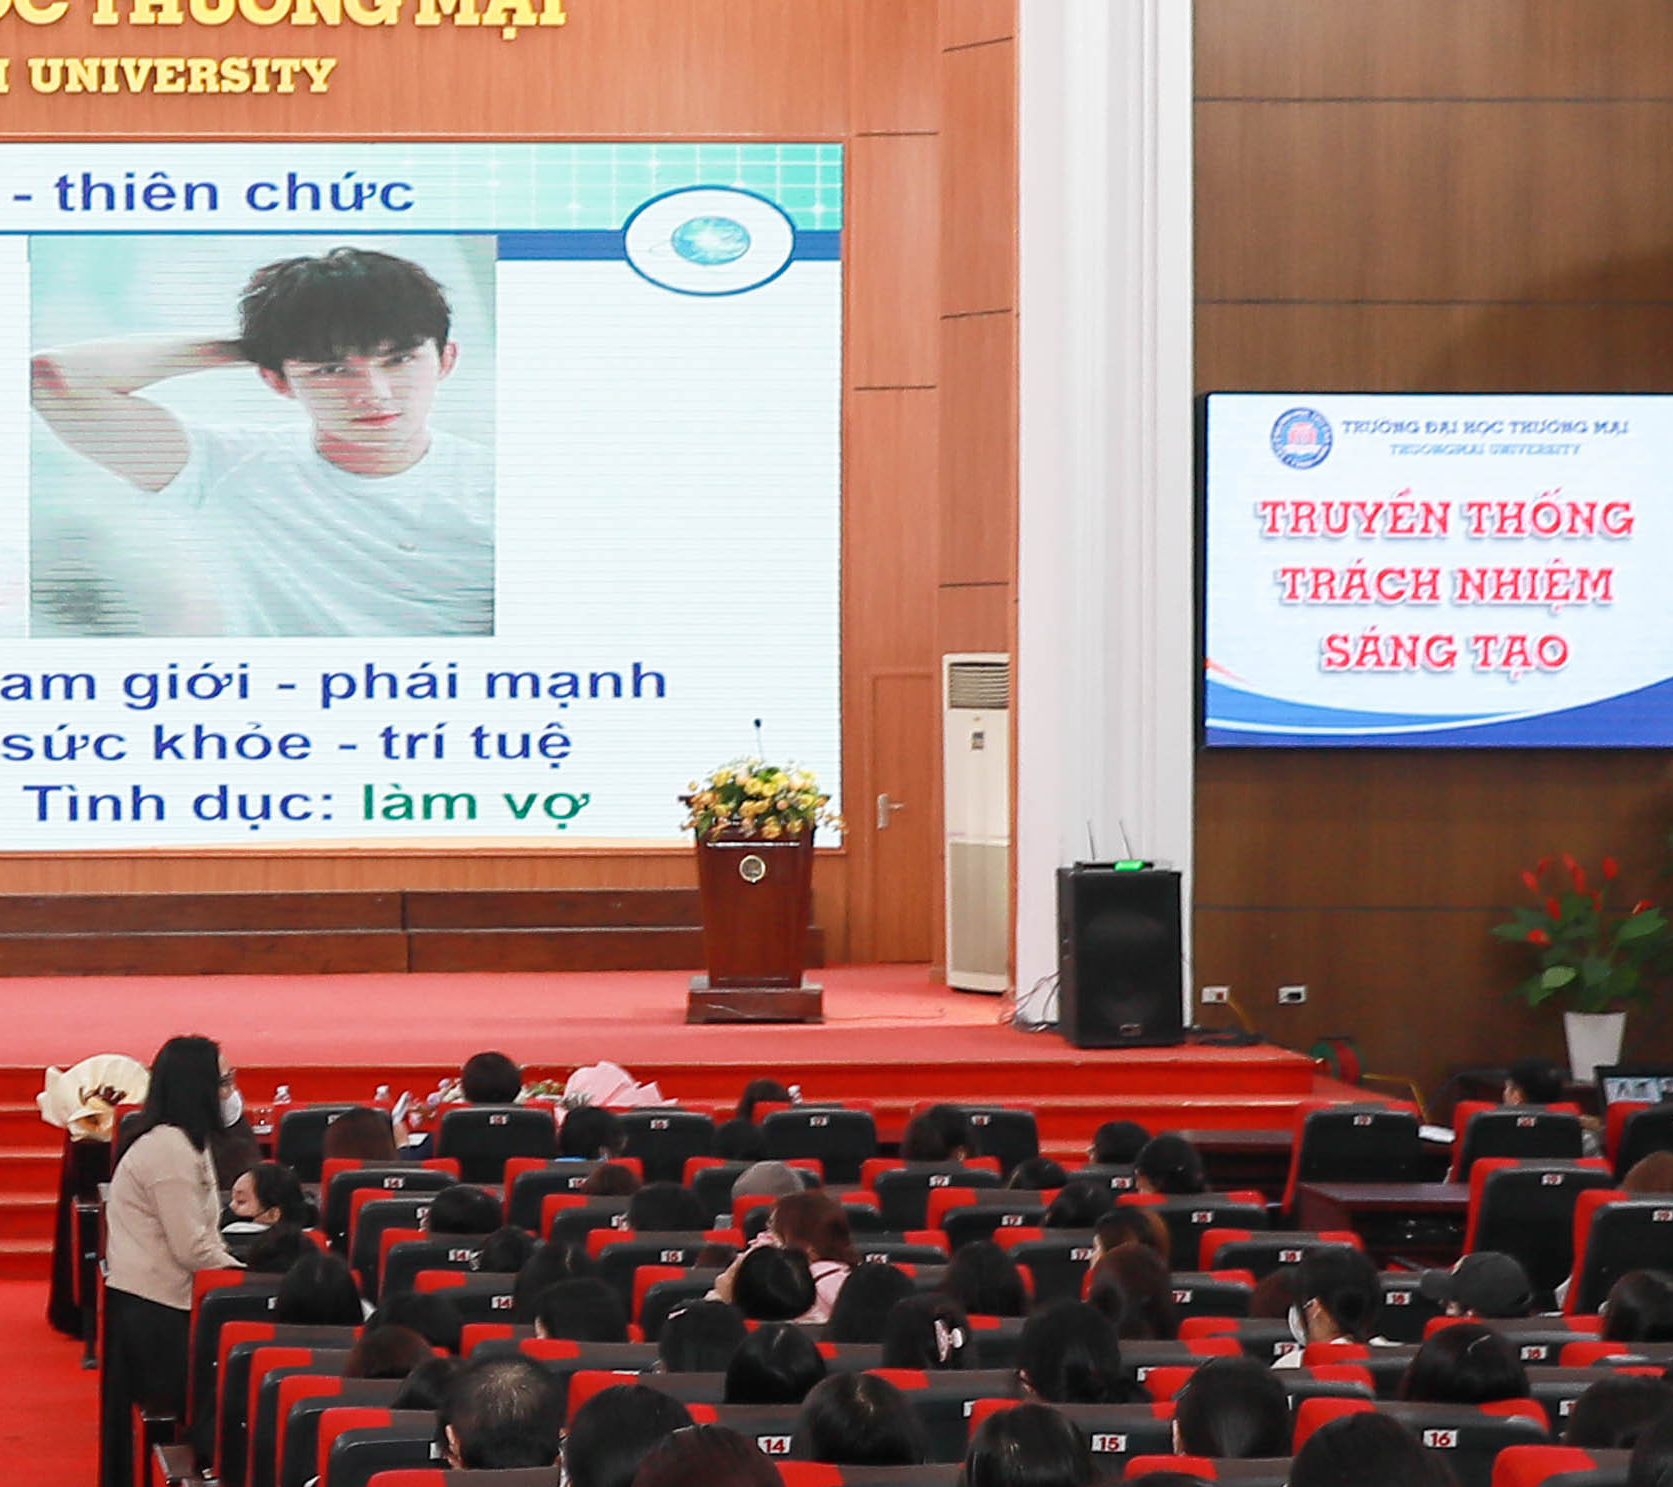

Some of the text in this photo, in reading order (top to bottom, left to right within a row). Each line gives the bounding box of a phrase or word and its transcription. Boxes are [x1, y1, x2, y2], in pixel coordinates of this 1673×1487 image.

[28, 57, 337, 94] UNIVERSITY
[54, 171, 218, 212] thiên
[245, 171, 414, 212] chức
[1281, 558, 1614, 612] TRÁCH NHIỆM
[1324, 624, 1569, 677] SÁNG TẠO
[123, 662, 250, 711] giới
[321, 661, 458, 710] phái
[486, 661, 666, 709] mạnh
[1, 723, 126, 762] sức
[154, 723, 312, 761] khỏe
[380, 722, 446, 761] trí
[470, 722, 572, 769] tuệ
[22, 784, 166, 822] Tình
[192, 784, 332, 831] dục:
[363, 783, 478, 821] làm
[503, 792, 591, 830] vợ
[764, 1439, 786, 1452] 14
[1100, 1436, 1120, 1452] 15
[1432, 1431, 1452, 1447] 16
